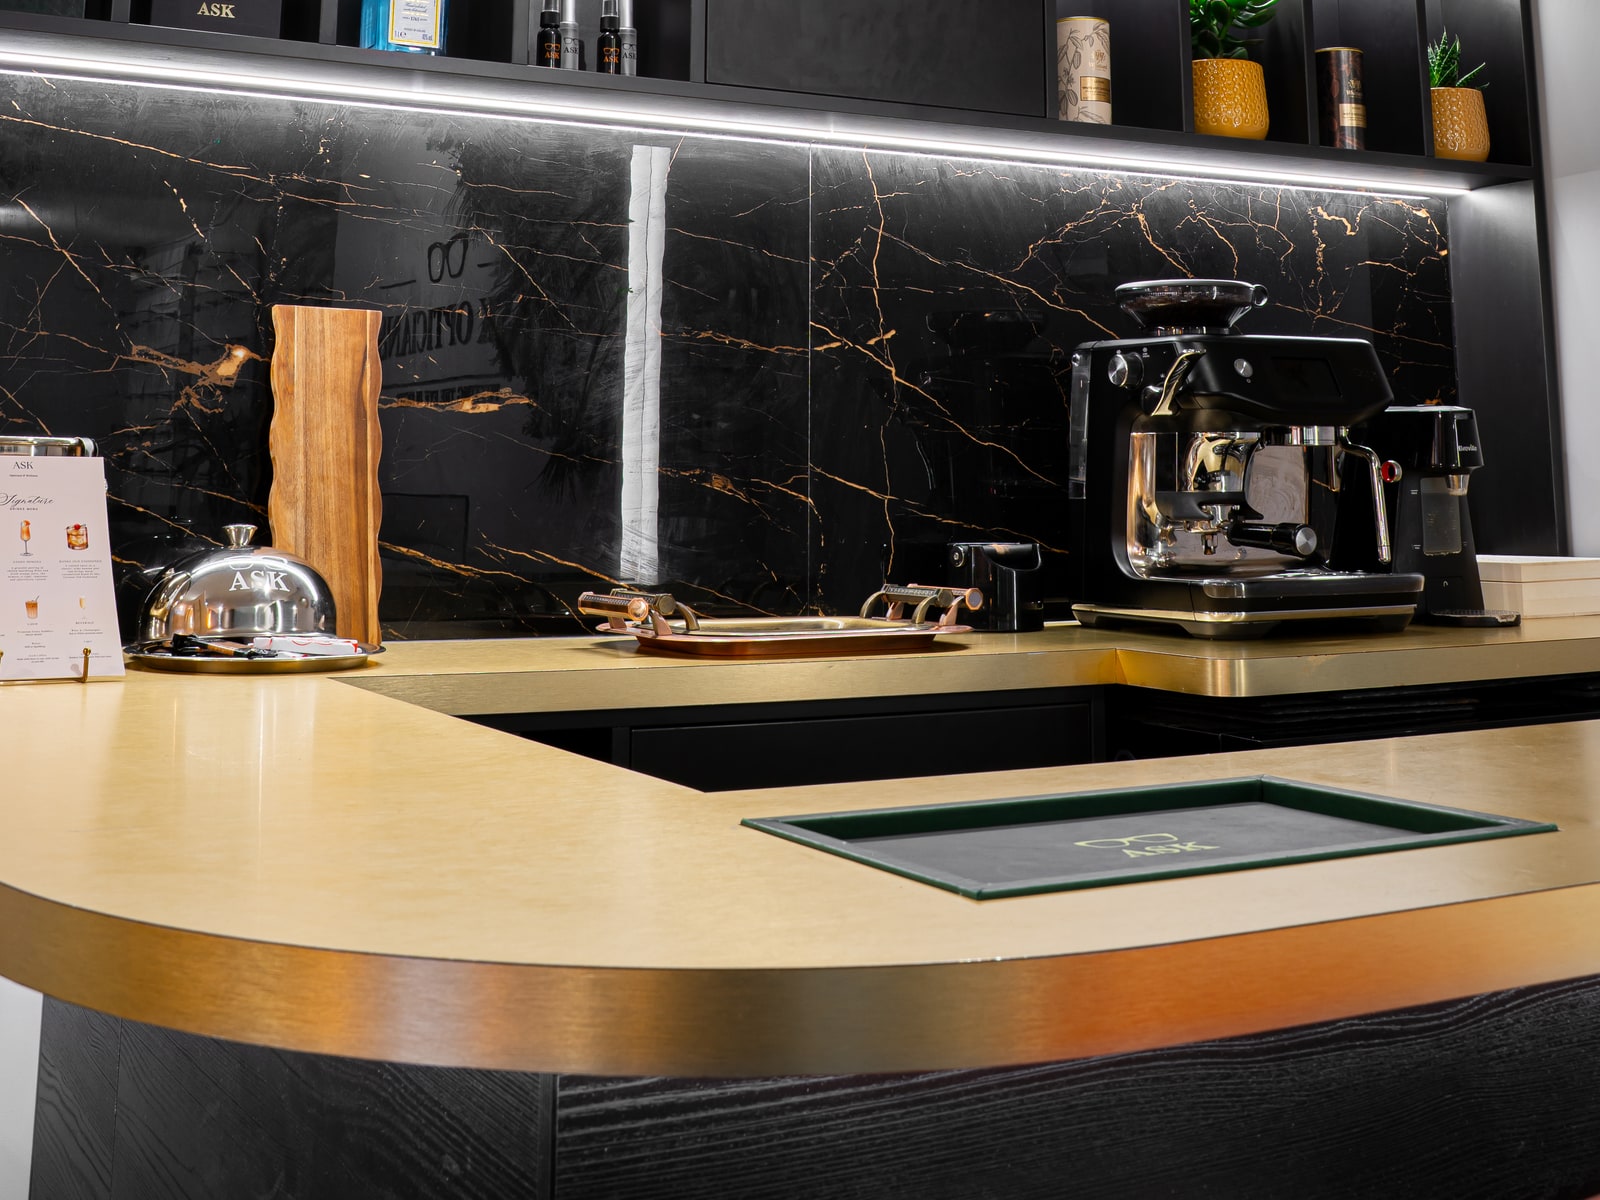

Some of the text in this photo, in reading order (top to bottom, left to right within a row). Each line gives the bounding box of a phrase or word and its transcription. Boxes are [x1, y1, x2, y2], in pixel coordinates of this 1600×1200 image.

[197, 2, 236, 18] ASK
[545, 51, 560, 60] ASK
[604, 56, 618, 64] ASK
[13, 461, 34, 470] ASK
[0, 493, 55, 507] Signature
[229, 570, 291, 592] ASK
[1122, 841, 1220, 858] ASK
